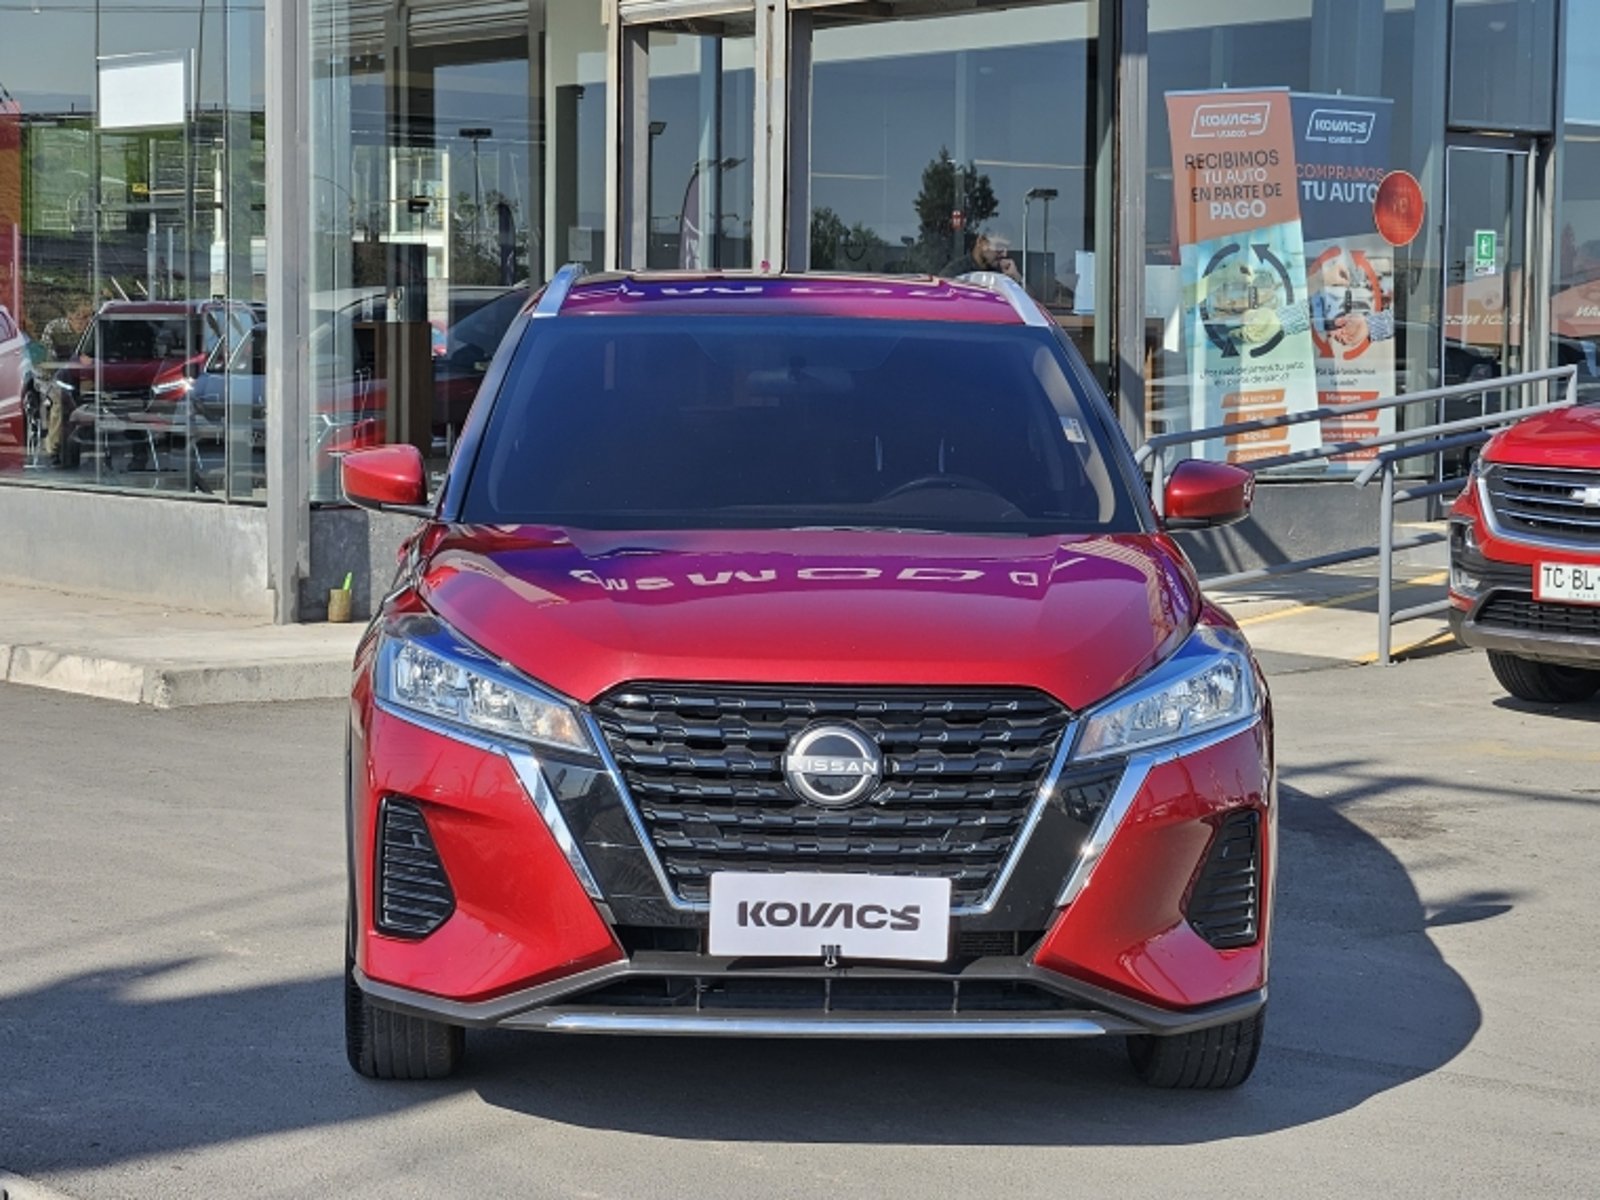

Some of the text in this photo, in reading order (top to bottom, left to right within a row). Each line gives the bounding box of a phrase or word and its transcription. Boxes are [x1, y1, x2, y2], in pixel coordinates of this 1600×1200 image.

[1200, 112, 1262, 127] KOVACS
[1315, 119, 1367, 134] KOVACS
[1184, 149, 1280, 170] RECIBIMOS
[1203, 167, 1268, 184] TU AUTO
[1297, 163, 1384, 181] COMPRAMOS
[1192, 182, 1283, 202] EN PARTE DE
[1301, 181, 1378, 203] TU AUTO
[1209, 199, 1267, 220] PAGO
[1543, 566, 1565, 588] TC
[790, 757, 877, 773] NISSAN
[737, 901, 921, 931] KOVACS
